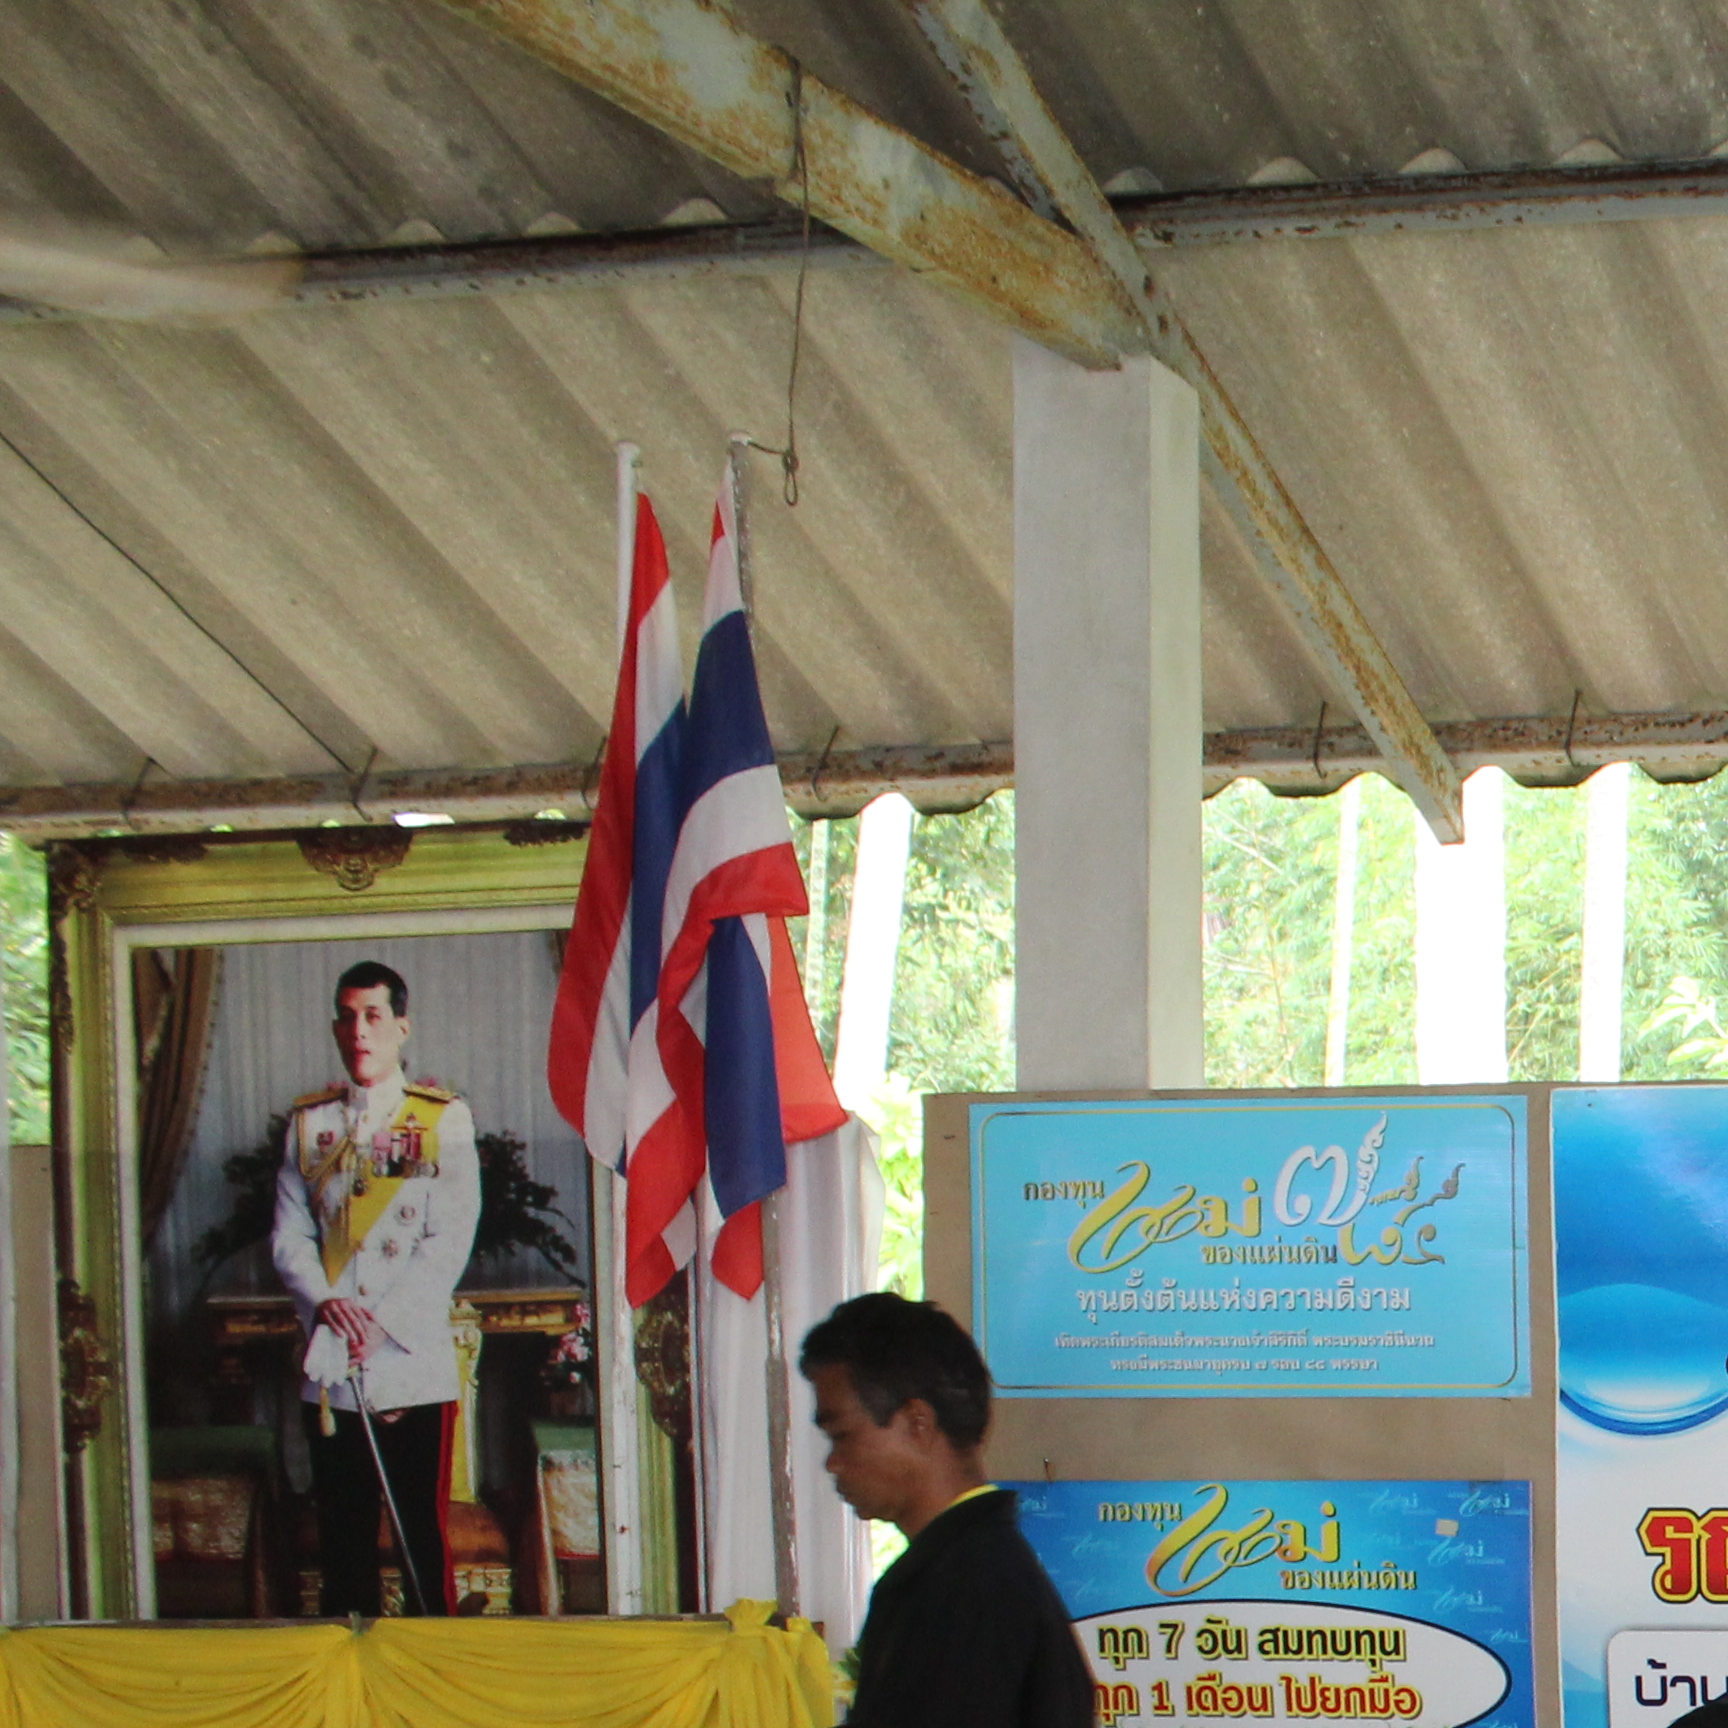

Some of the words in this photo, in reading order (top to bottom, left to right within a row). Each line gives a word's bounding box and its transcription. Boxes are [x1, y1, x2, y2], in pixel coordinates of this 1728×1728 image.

[1023, 1179, 1105, 1208] กองทุน
[1201, 1235, 1338, 1265] ของแผ่นดิน
[1076, 1269, 1412, 1324] ทุนตั้งต้นแห่งความดีงาม
[1098, 1501, 1182, 1531] กองทุน
[1279, 1561, 1417, 1591] ของแผ่นดิน
[1097, 1623, 1149, 1671] ทุก
[1158, 1621, 1187, 1660] 7
[1195, 1615, 1248, 1660] วัน
[1257, 1622, 1407, 1669] สมทบทุน
[1150, 1679, 1175, 1717] 1
[1184, 1672, 1270, 1718] เดือน
[1281, 1671, 1424, 1720] ไปยกมือ
